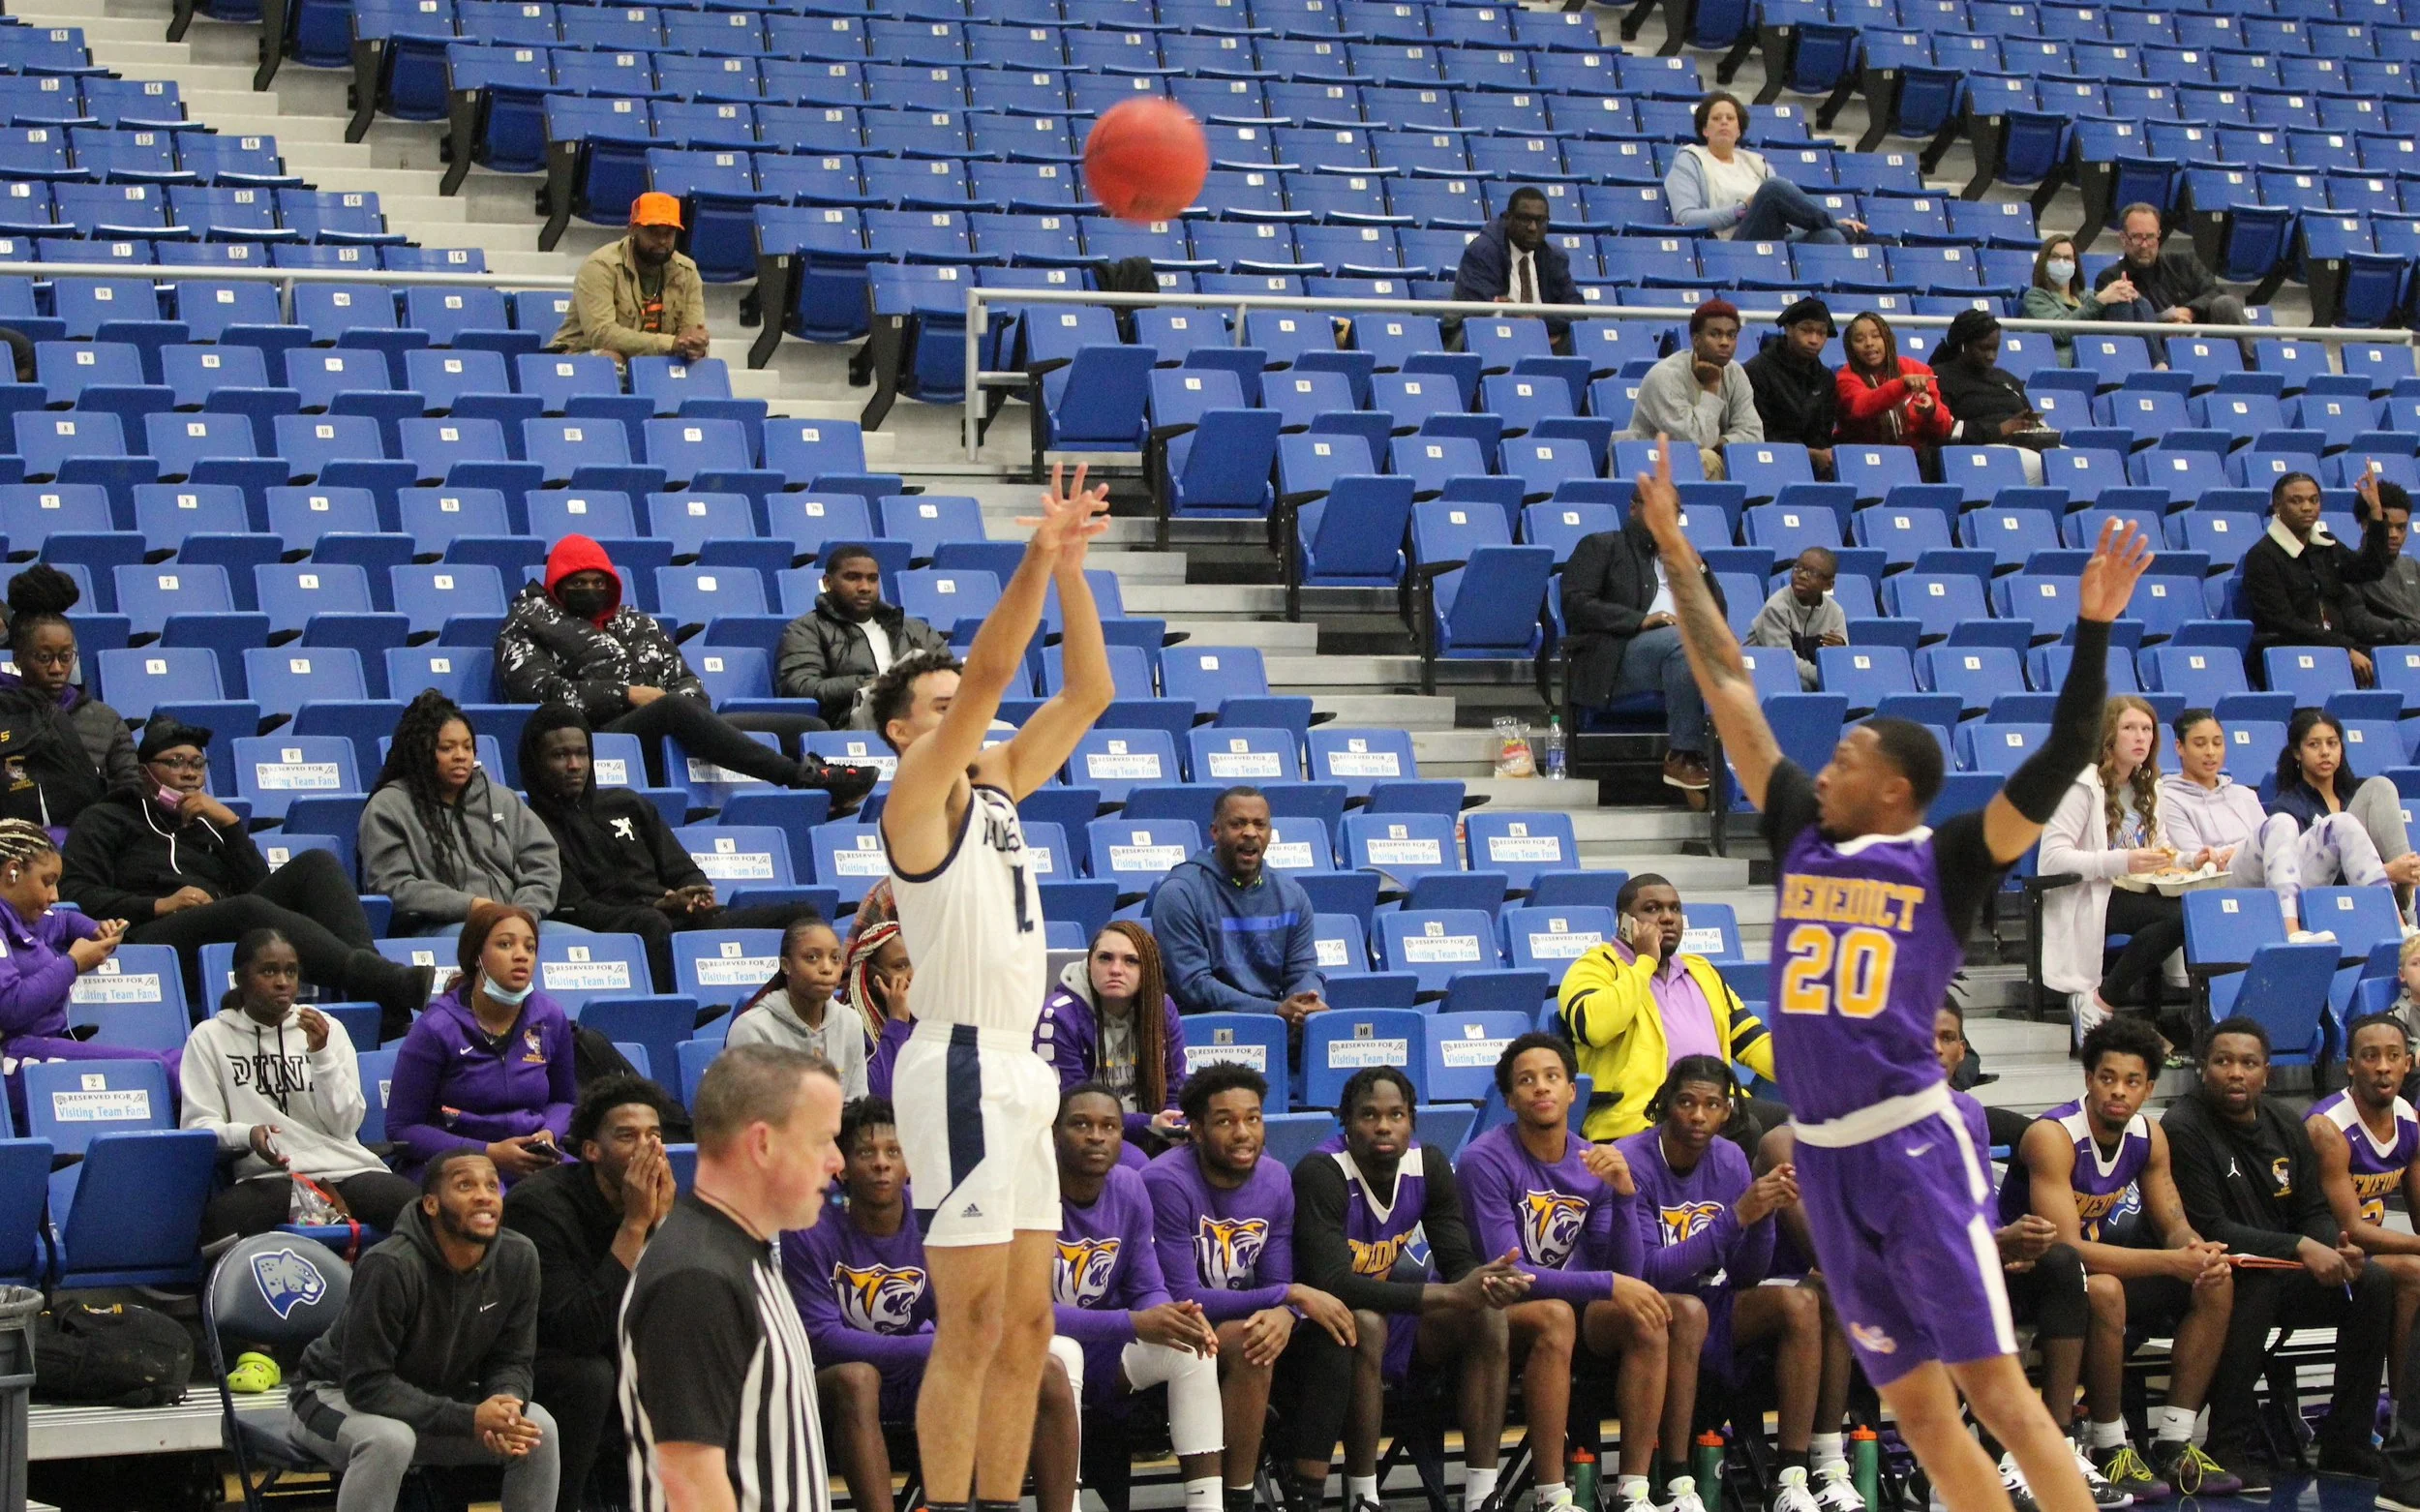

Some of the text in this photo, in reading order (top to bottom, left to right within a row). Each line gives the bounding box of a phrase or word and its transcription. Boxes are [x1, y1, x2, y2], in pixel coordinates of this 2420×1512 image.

[1493, 849, 1520, 860] Visiting
[752, 865, 771, 874] Fans
[839, 863, 868, 874] Visiting
[1115, 859, 1142, 869] Visiting
[1779, 873, 1925, 932] BENEDICT
[1408, 950, 1437, 960] Visiting
[1534, 946, 1560, 956] Visiting
[1779, 922, 1897, 1019] 20
[547, 975, 626, 987] Visiting Team Fans
[701, 971, 731, 983] Visiting
[736, 971, 757, 980] Team
[111, 989, 135, 998] Team
[137, 987, 158, 997] Fans
[1331, 1053, 1405, 1067] Visiting Team Fans
[1446, 1053, 1498, 1065] Visiting Team
[227, 1054, 315, 1095] PIN
[58, 1104, 146, 1120] Visiting Team Fans
